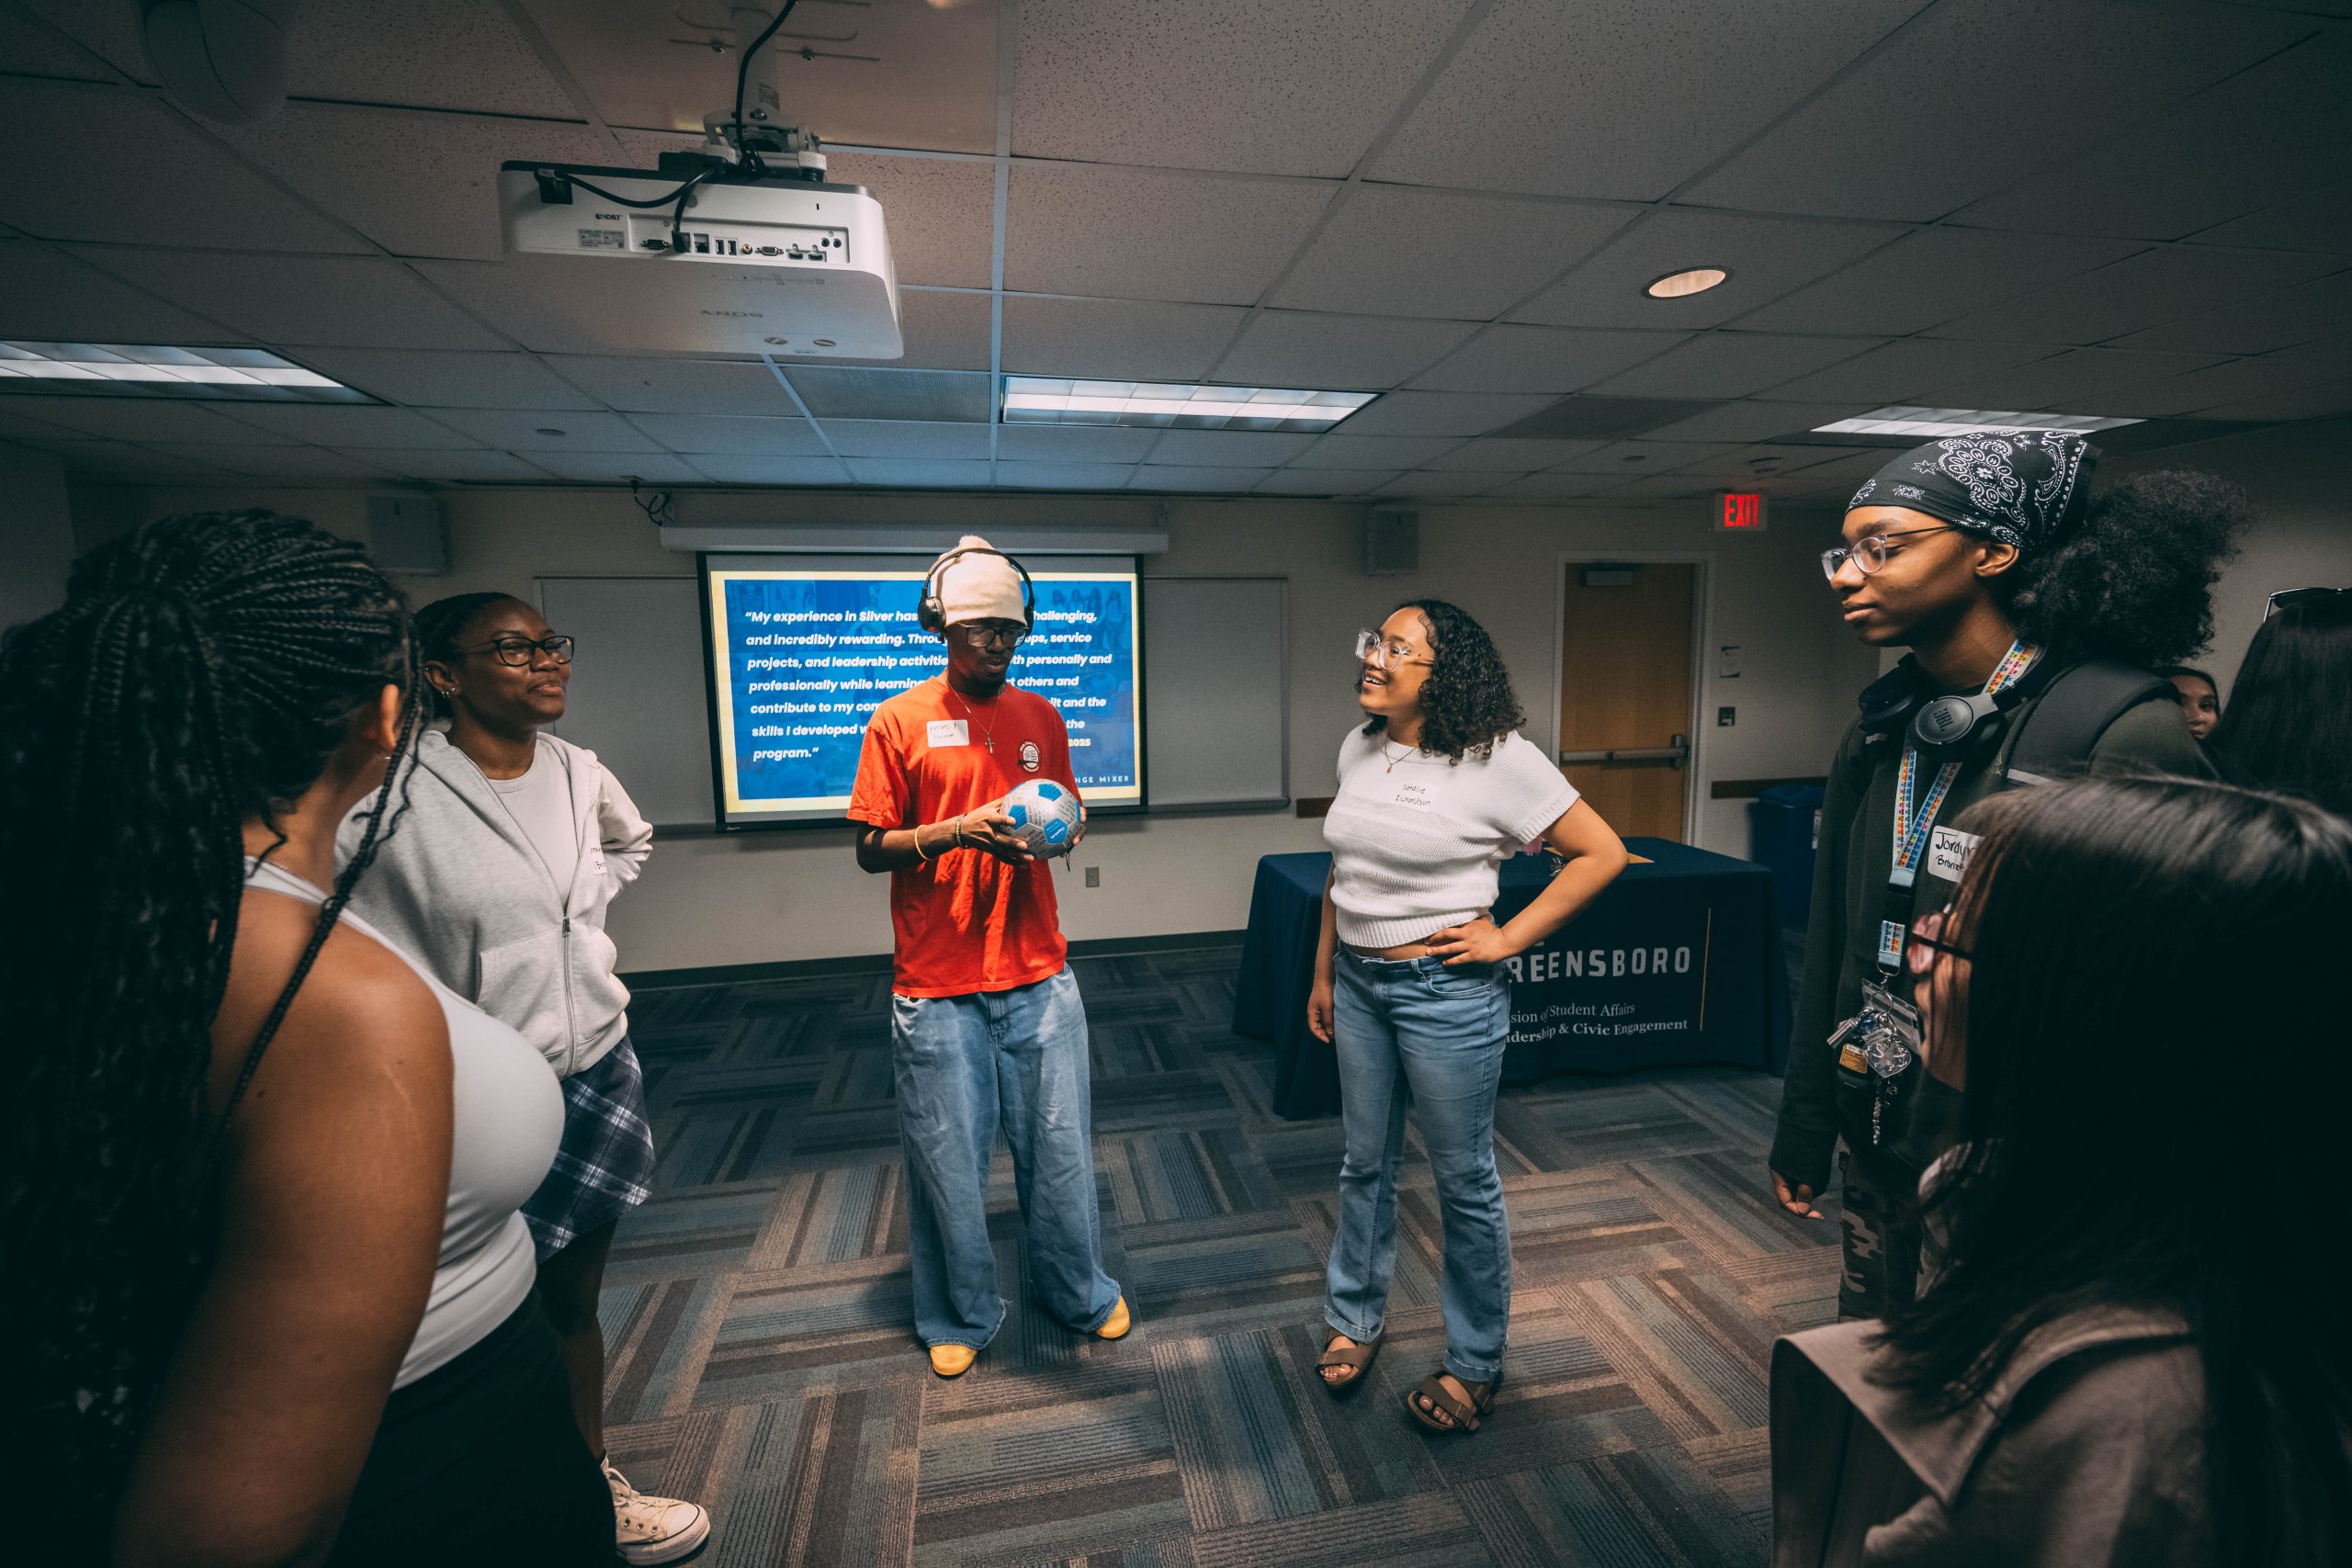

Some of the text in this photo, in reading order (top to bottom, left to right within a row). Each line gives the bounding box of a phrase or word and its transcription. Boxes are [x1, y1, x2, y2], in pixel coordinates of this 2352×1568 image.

[1724, 494, 1759, 527] EXIT
[744, 610, 1097, 625] “My experience in Silver has hallenging,
[746, 634, 772, 646] and
[774, 634, 837, 648] incredibly
[839, 633, 906, 647] rewarding.
[1050, 632, 1092, 643] service
[747, 656, 802, 671] projects,
[805, 656, 830, 668] and
[831, 655, 898, 670] leadership
[899, 655, 949, 666] activitie
[1026, 653, 1088, 667] personally
[1089, 653, 1113, 664] and
[749, 679, 838, 694] professionally
[840, 678, 873, 690] while
[1017, 676, 1054, 686] others
[1056, 676, 1080, 686] and
[750, 702, 816, 714] contribute
[819, 702, 831, 712] to
[833, 702, 854, 716] my
[1063, 697, 1086, 707] and
[1087, 696, 1106, 707] the
[752, 725, 784, 737] skills
[786, 726, 790, 736] I
[792, 724, 858, 738] developed
[1066, 718, 1085, 729] the
[1069, 738, 1091, 747] 2025
[753, 747, 820, 761] program.”
[1507, 946, 1690, 984] REENSBORO
[1510, 1002, 1635, 1023] sion of Student Affairs
[1504, 1019, 1689, 1043] adership & Civic Engagement
